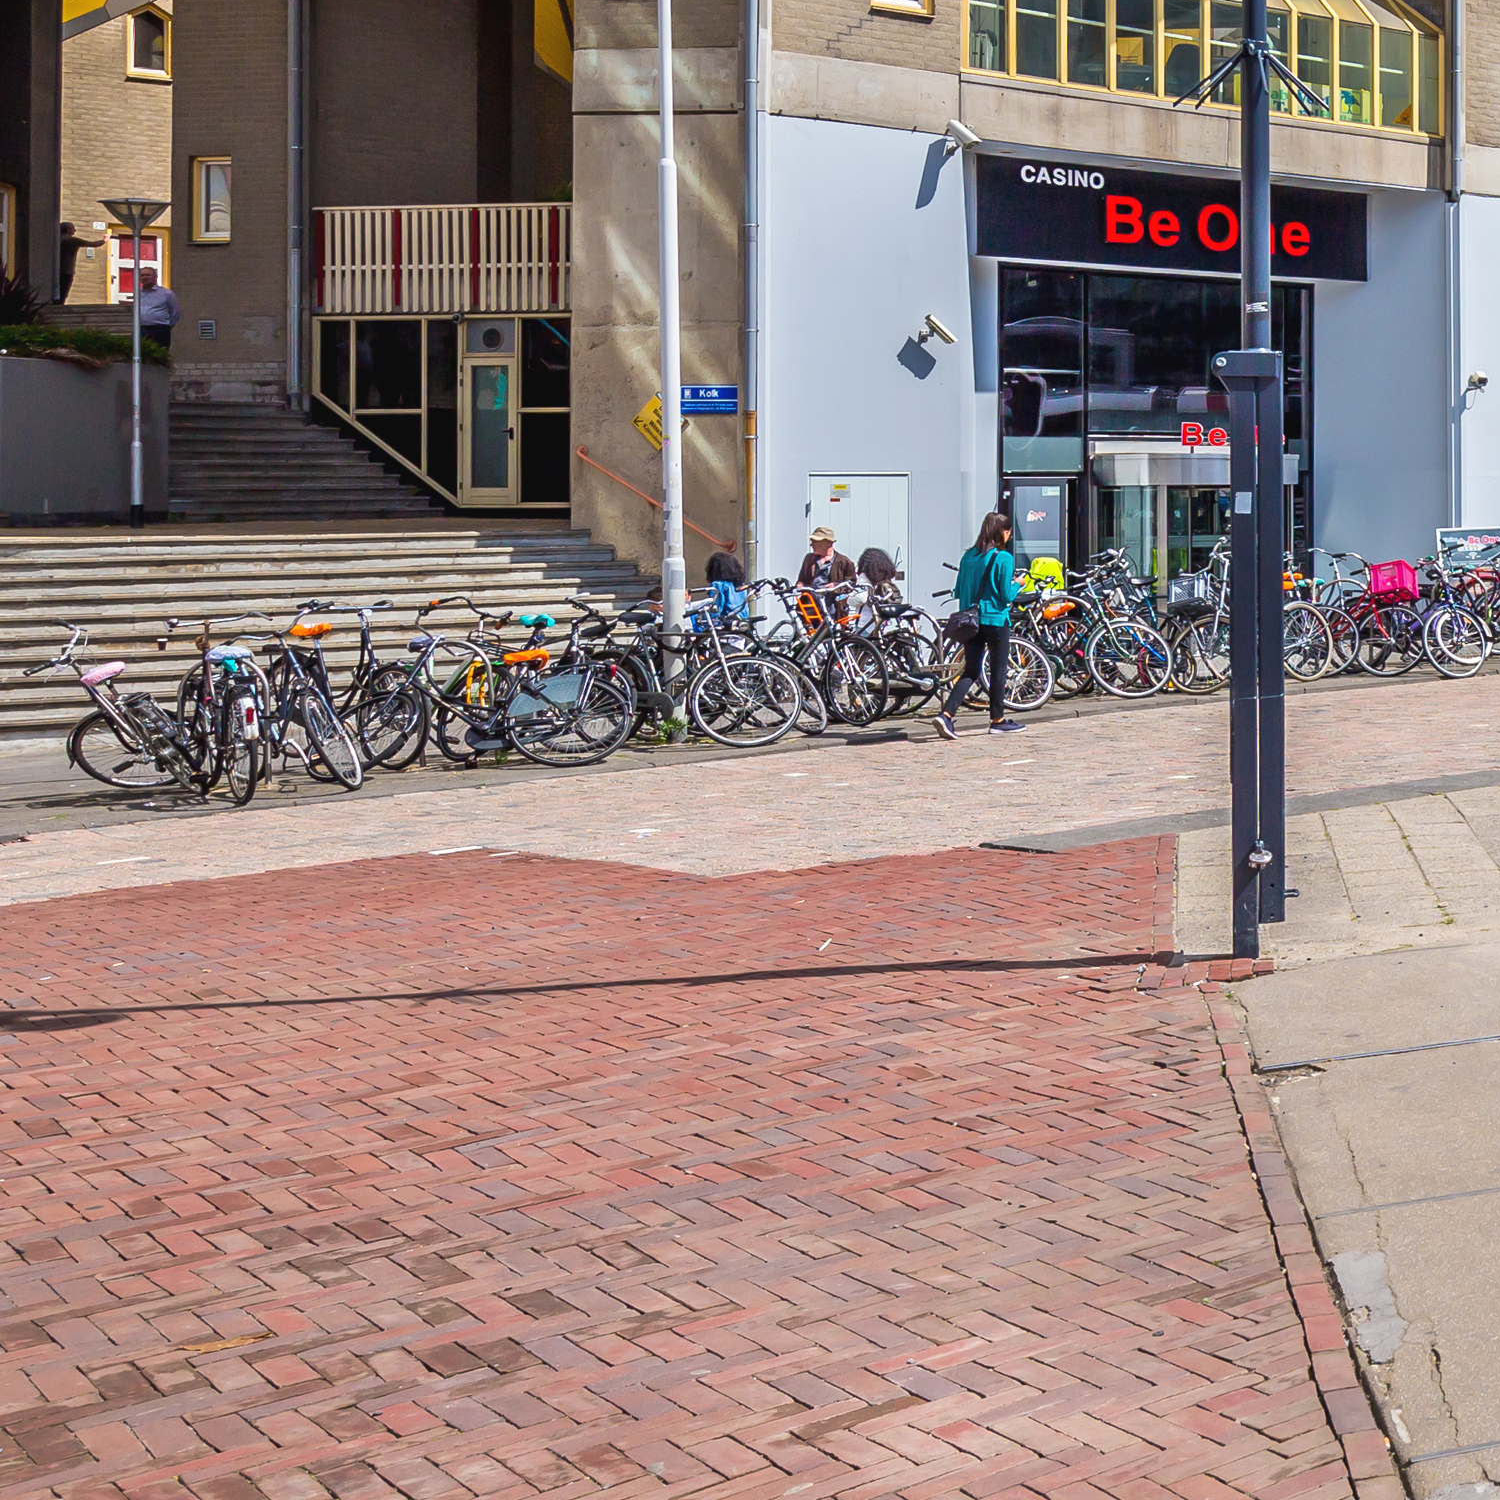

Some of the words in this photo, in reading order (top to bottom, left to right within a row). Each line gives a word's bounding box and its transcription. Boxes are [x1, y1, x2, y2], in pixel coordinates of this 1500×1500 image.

[1020, 165, 1105, 190] CASINO
[1106, 194, 1181, 247] Be
[1197, 203, 1310, 257] Oe
[699, 388, 719, 398] Kolk
[1181, 421, 1228, 447] Be
